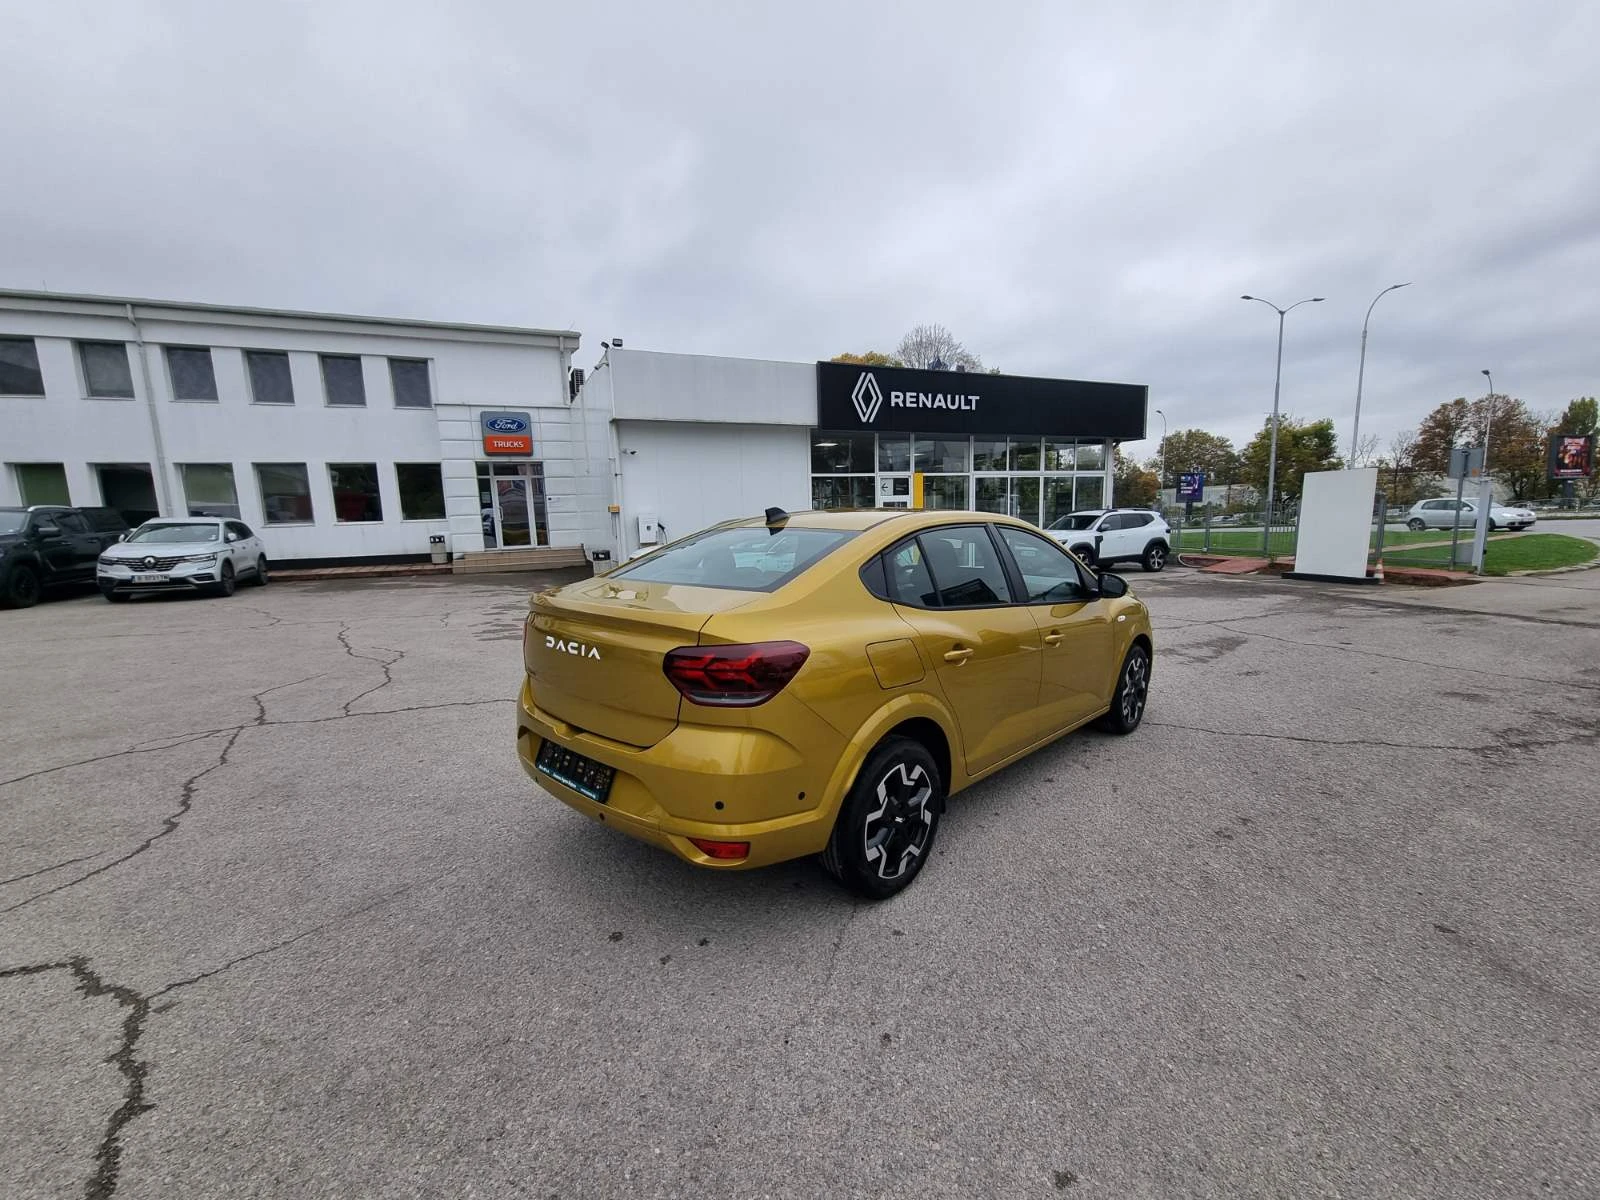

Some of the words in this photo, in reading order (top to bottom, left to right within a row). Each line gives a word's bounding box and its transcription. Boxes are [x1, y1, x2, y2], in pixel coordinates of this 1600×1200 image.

[890, 391, 980, 411] RENAULT
[494, 419, 519, 430] Ford
[494, 440, 524, 448] TRUCKS
[545, 635, 601, 660] DACIA
